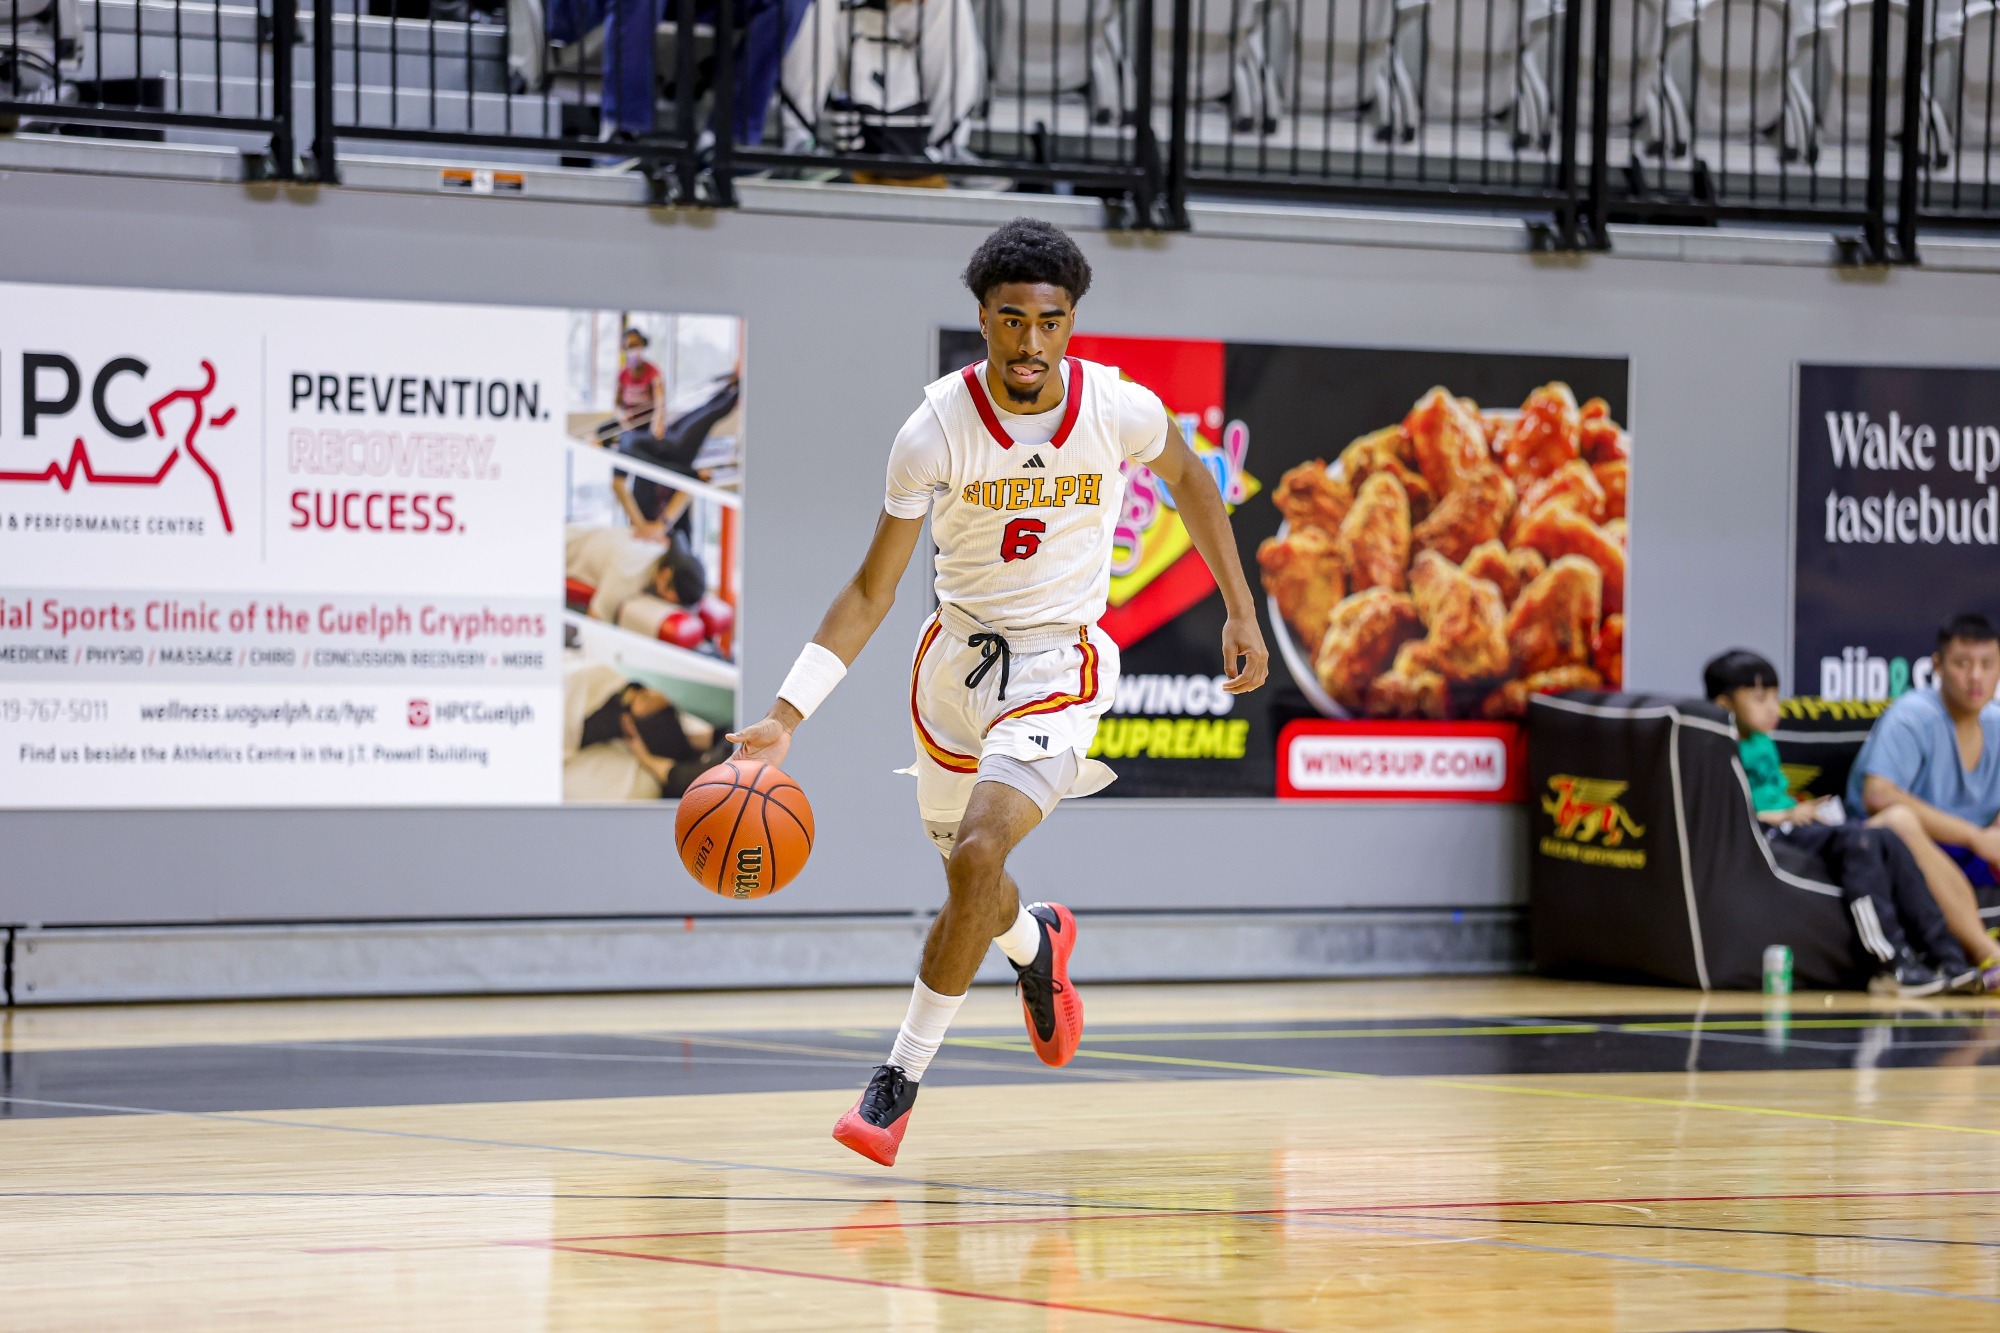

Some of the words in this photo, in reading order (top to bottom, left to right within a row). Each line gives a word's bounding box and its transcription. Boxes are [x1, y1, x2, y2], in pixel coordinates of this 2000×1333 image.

[0, 348, 149, 440] PC
[290, 372, 550, 421] PREVENTION.
[287, 427, 503, 480] RECOVERY.
[1825, 411, 1937, 471] Wake
[1948, 425, 2000, 484] up
[289, 490, 467, 534] SUCCESS.
[962, 474, 1102, 511] GUELPH
[24, 513, 142, 534] PERFORMANCE
[147, 516, 206, 536] CENTRE
[1000, 518, 1047, 563] 6
[42, 599, 137, 638] Sports
[145, 602, 221, 633] Clinic
[228, 602, 259, 633] of
[265, 603, 310, 635] the
[318, 603, 412, 642] Guelph
[420, 605, 546, 644] Gryphons
[86, 646, 145, 666] PHYSIO
[159, 647, 234, 667] MASSAGE
[250, 648, 296, 668] CHIRO
[313, 648, 407, 668] CONCUSSION
[410, 649, 487, 669] RECOVERY
[502, 650, 544, 670] MORE
[0, 698, 109, 723] 19-767-5011
[434, 700, 536, 729] HPCGuelph
[1111, 674, 1235, 716] WINGS
[20, 743, 56, 764] Find
[60, 748, 80, 764] us
[84, 744, 137, 764] beside
[141, 745, 169, 765] the
[172, 745, 244, 766] Athletics
[246, 744, 297, 766] Centre
[301, 745, 316, 765] in
[319, 746, 345, 766] the
[372, 746, 423, 767] Powell
[427, 747, 489, 769] Building
[1301, 749, 1496, 777] WINGSUP.COM
